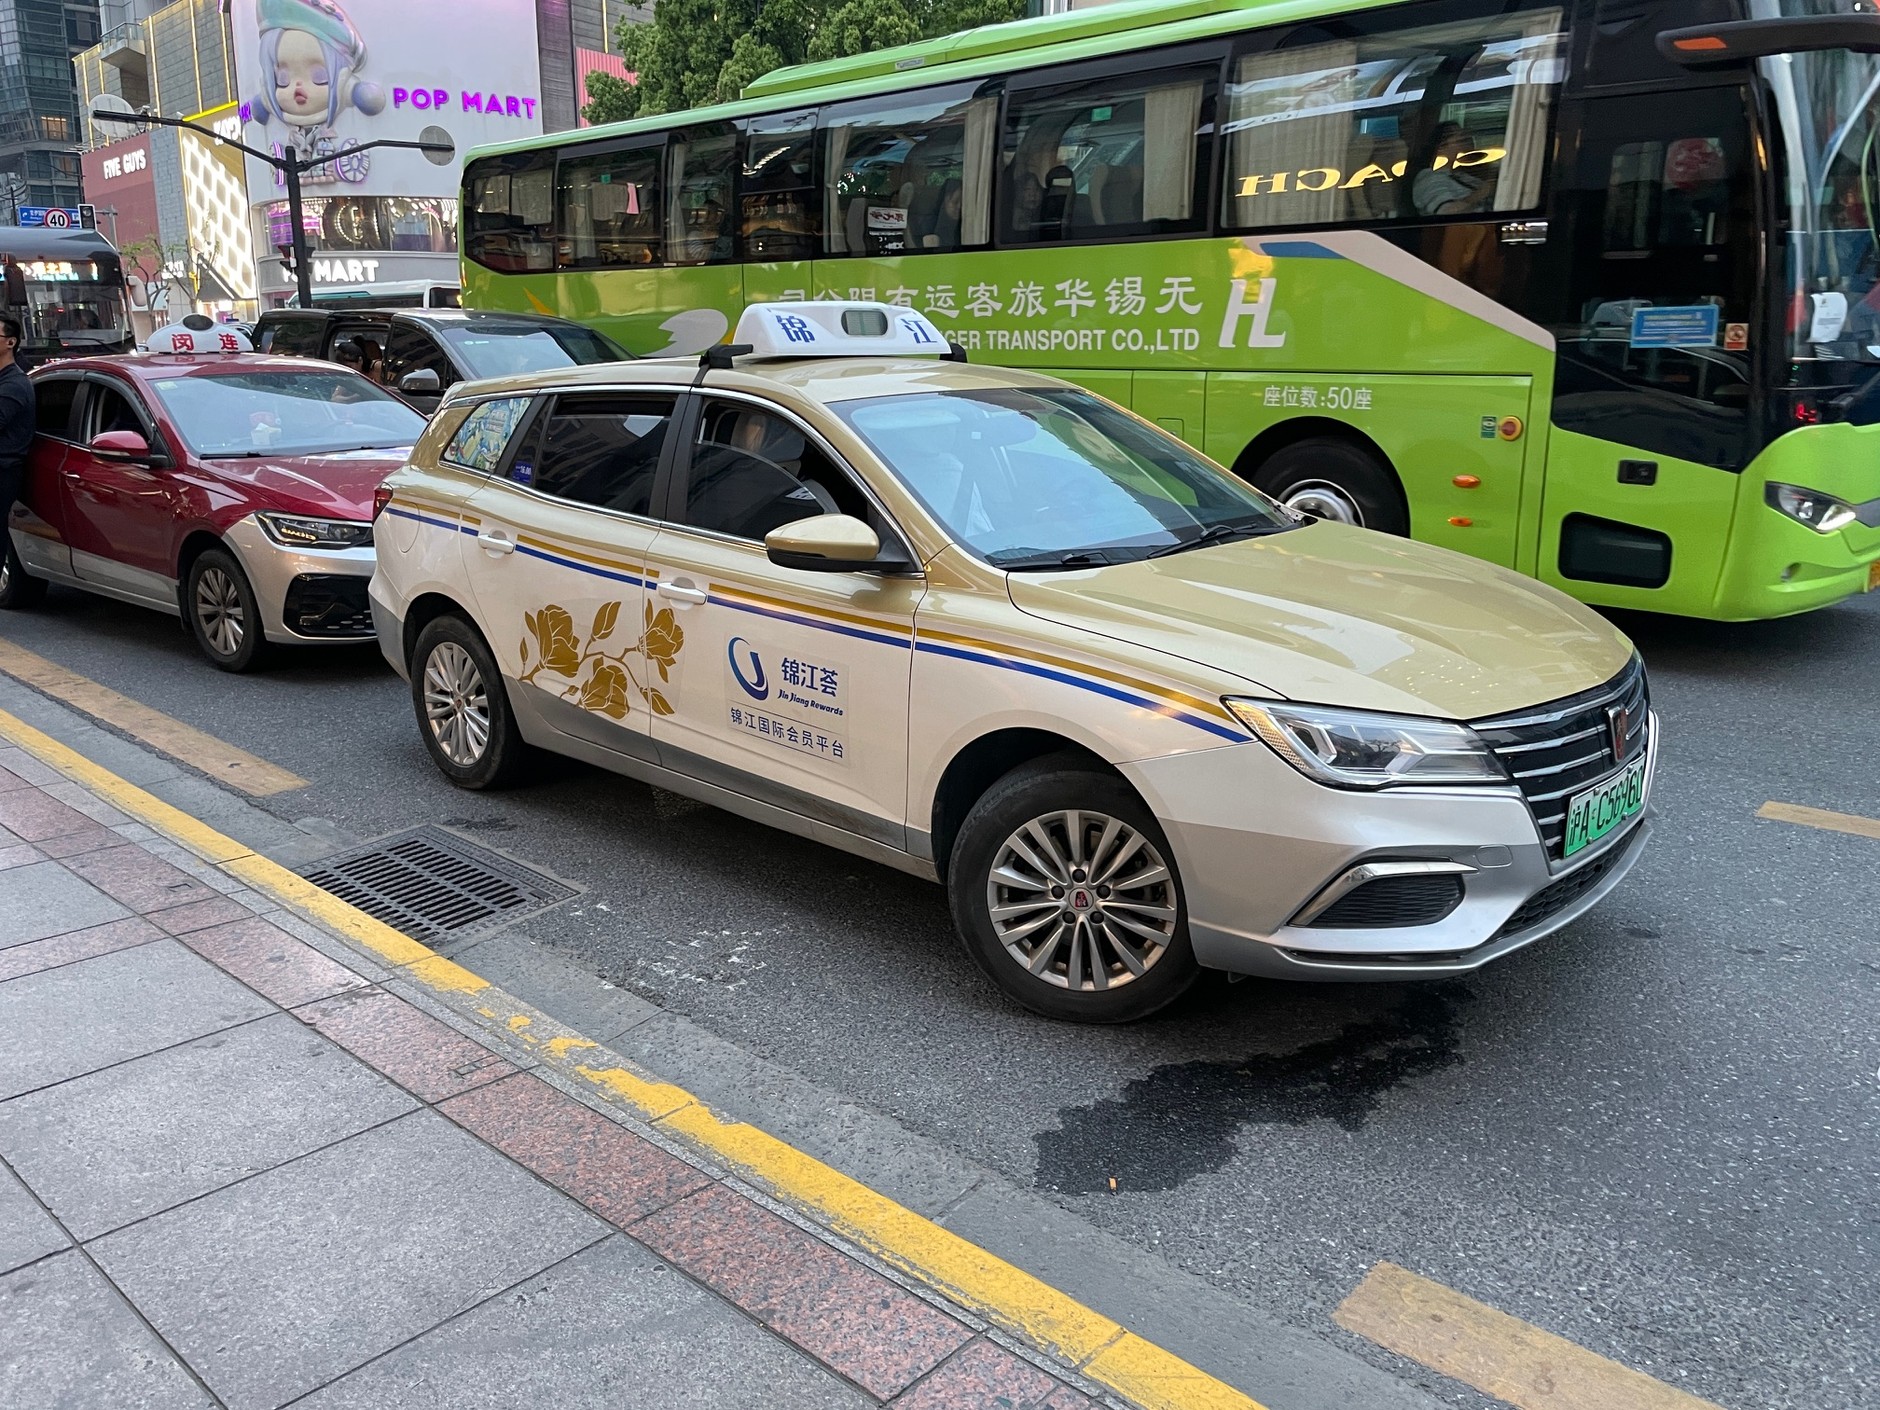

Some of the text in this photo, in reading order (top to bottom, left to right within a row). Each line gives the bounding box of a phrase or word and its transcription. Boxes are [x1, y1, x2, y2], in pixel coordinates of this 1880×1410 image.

[393, 87, 536, 119] POP MART
[103, 149, 146, 180] FIVE GUYS
[50, 214, 65, 227] 40
[313, 259, 379, 282] MART
[941, 329, 980, 350] GER
[985, 328, 1106, 351] TRANSPORT
[1263, 385, 1373, 410] 座位数:50座
[781, 657, 838, 697] 锦江荟
[777, 689, 844, 716] Jin Jiang Rewards
[730, 707, 844, 759] 锦江国际会员平台
